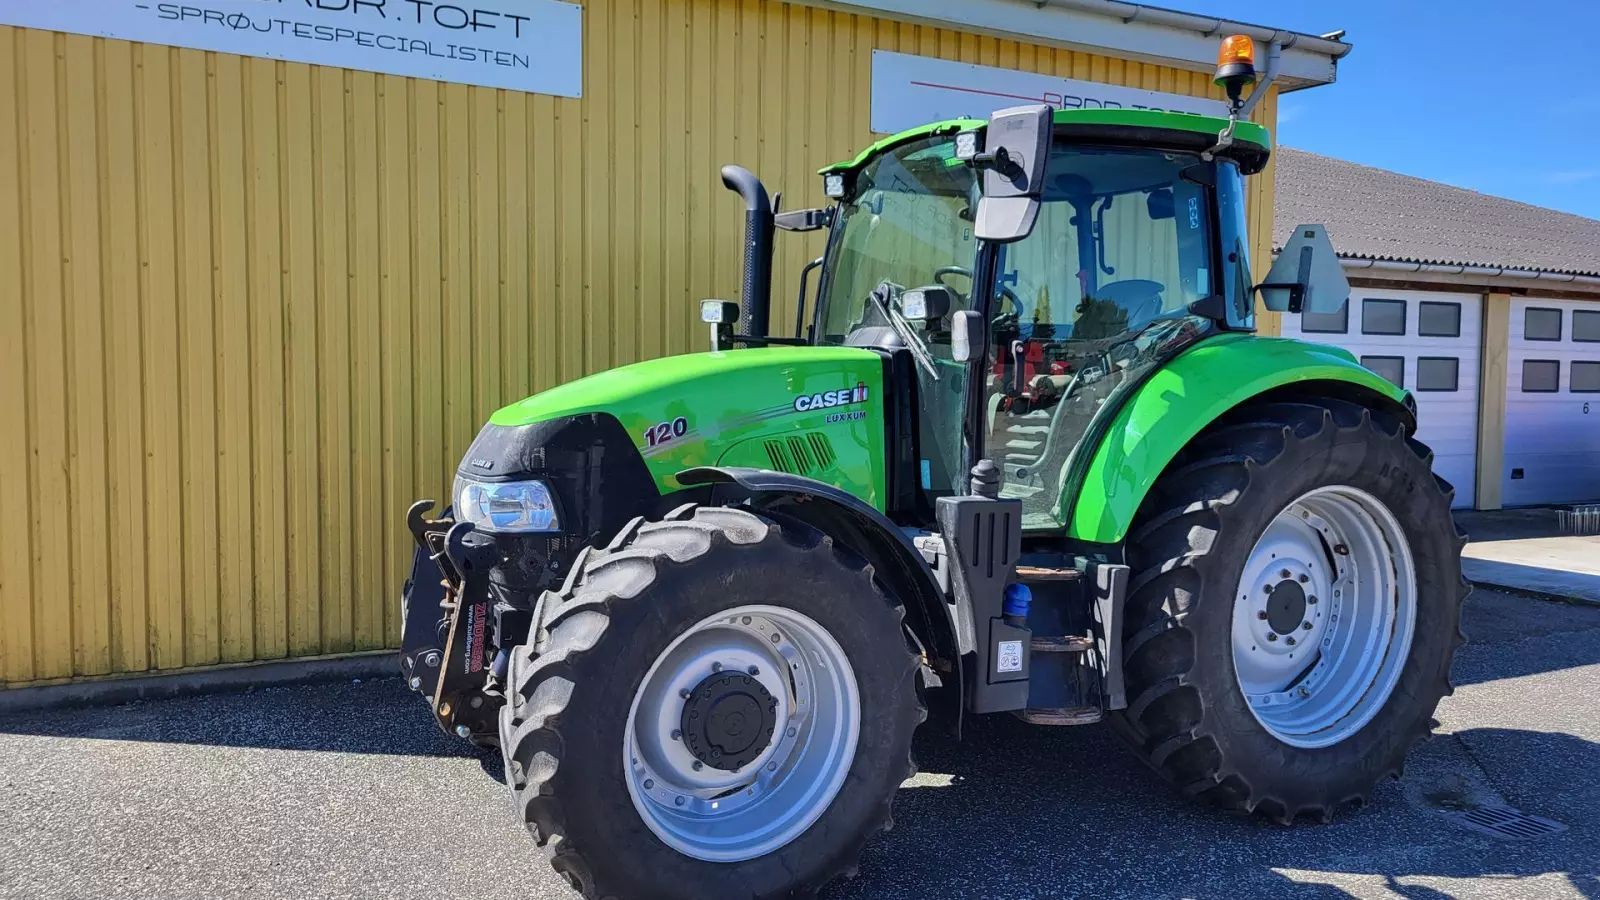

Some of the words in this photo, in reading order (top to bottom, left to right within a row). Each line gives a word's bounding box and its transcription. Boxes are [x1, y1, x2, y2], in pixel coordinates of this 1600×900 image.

[278, 0, 531, 38] R.TOFT
[157, 3, 529, 68] SPRØJTESPECIALISTEN
[794, 388, 851, 412] CASE
[1583, 402, 1590, 415] 6
[825, 411, 867, 423] LUXXUM
[643, 416, 688, 447] 120
